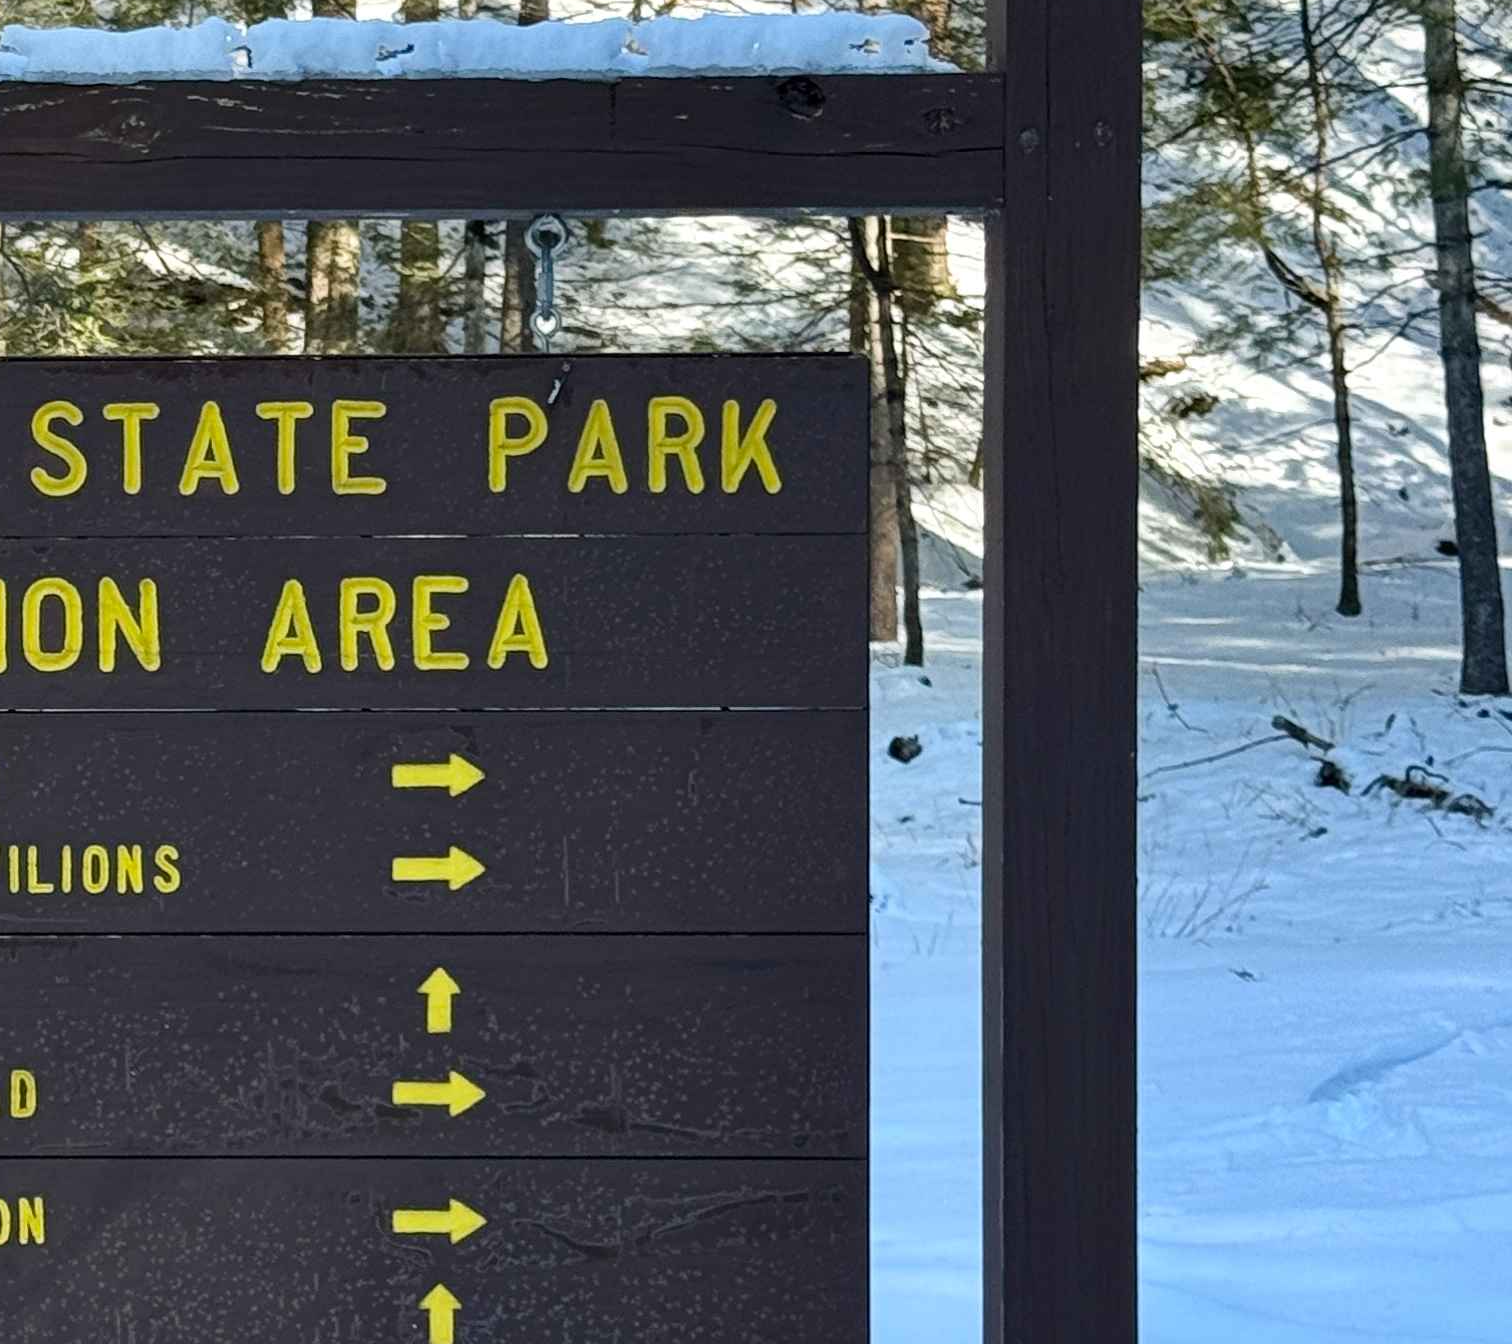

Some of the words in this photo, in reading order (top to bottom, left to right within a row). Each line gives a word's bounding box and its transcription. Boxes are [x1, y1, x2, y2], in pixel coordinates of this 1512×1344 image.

[29, 398, 388, 498] STATE
[487, 394, 784, 495] PARK
[259, 573, 551, 674] AREA
